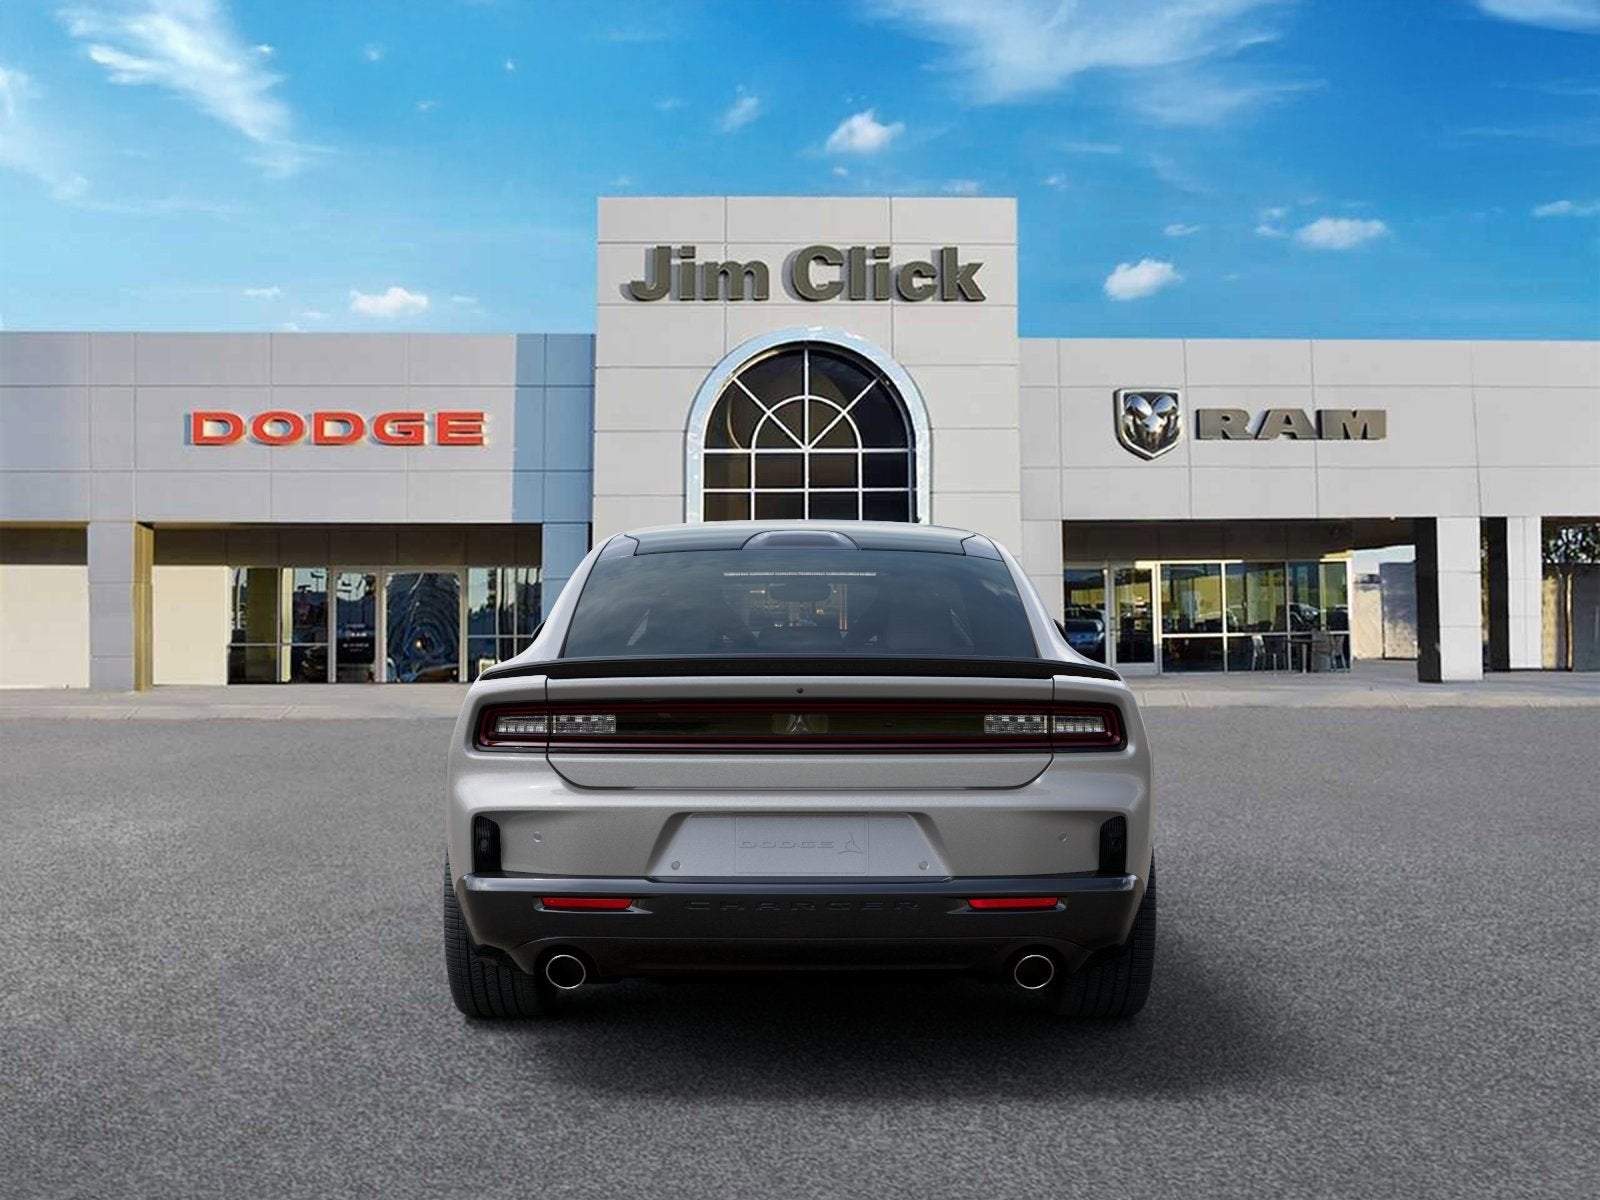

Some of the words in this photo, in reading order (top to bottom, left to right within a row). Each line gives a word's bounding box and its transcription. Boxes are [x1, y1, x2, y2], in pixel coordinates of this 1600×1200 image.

[627, 245, 770, 302] Jim
[790, 244, 987, 302] Click
[189, 410, 486, 447] DODGE
[1194, 408, 1387, 441] RAM
[738, 840, 835, 850] DODGE
[684, 901, 921, 912] CHARGER
